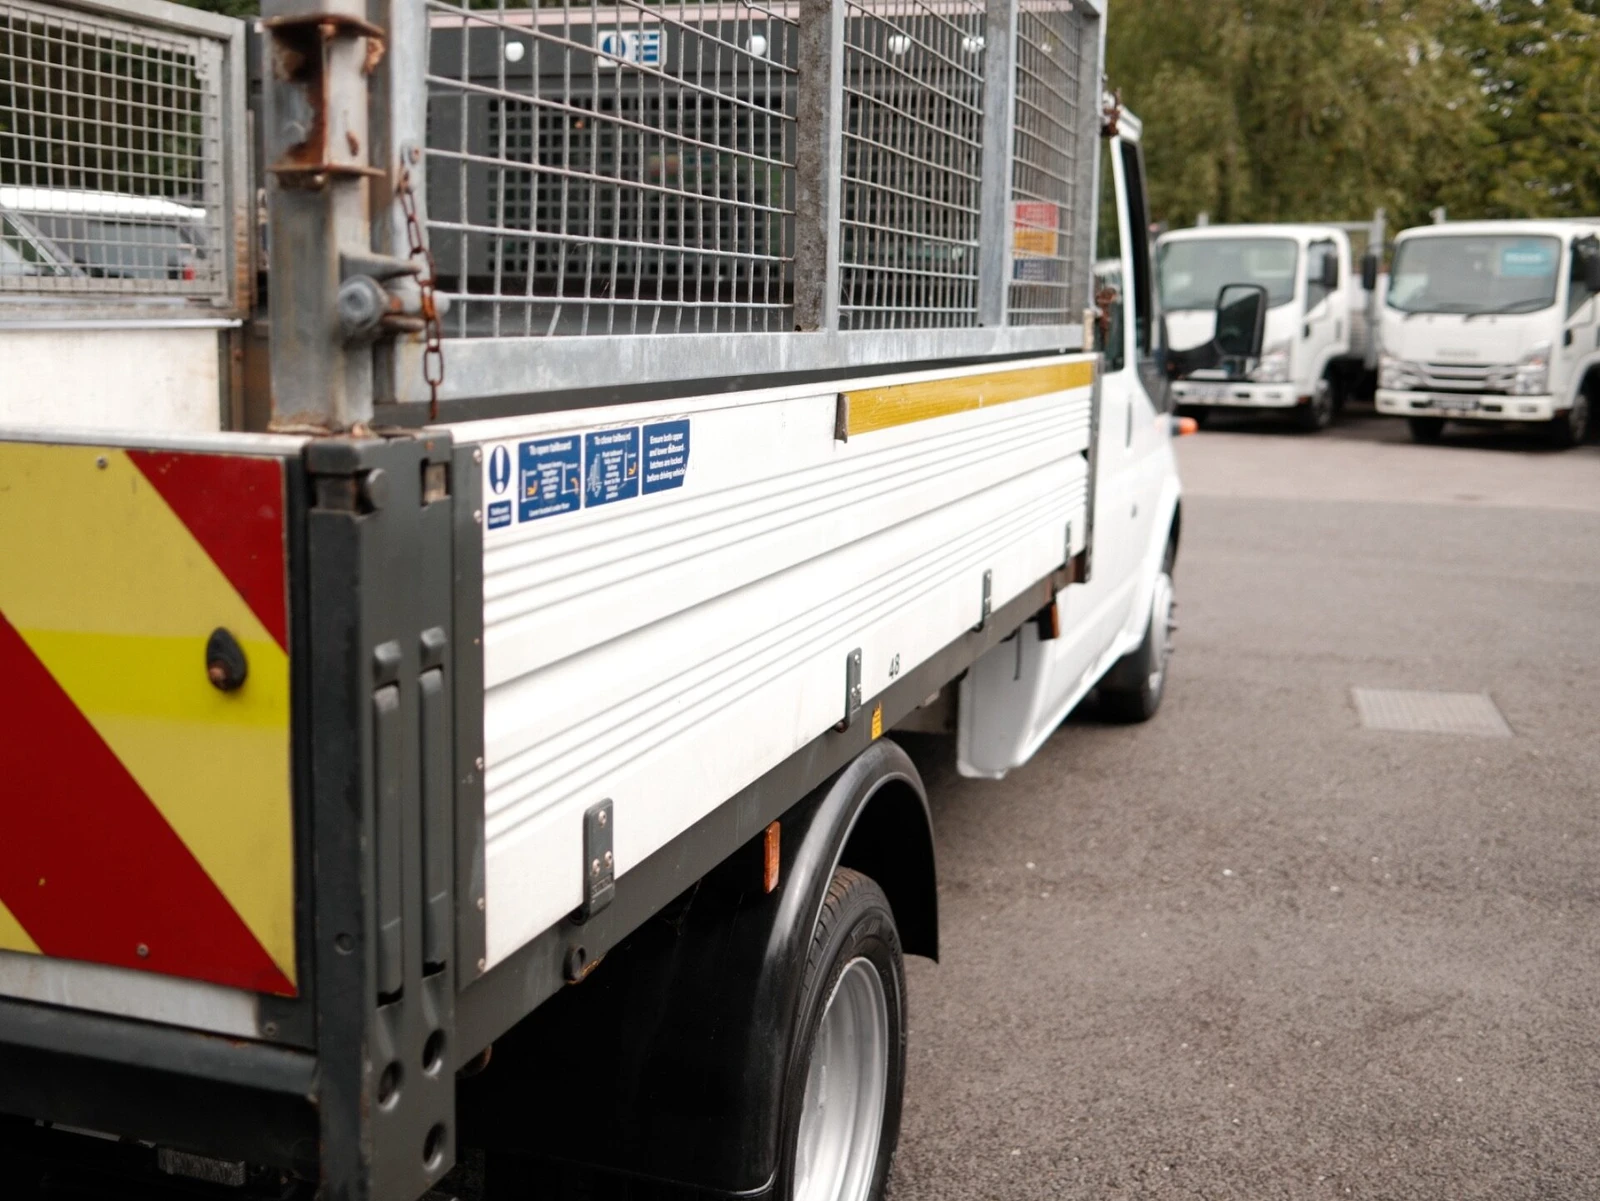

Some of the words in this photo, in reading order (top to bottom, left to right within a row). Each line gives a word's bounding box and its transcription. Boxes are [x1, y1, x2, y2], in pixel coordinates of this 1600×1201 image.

[650, 435, 664, 445] Ensure
[664, 433, 672, 442] both
[672, 432, 684, 442] upper
[649, 447, 657, 457] and
[657, 447, 668, 456] lower
[649, 459, 664, 470] latches
[670, 455, 683, 466] locked
[646, 472, 660, 483] before
[660, 470, 673, 481] driving
[888, 653, 900, 679] 48
